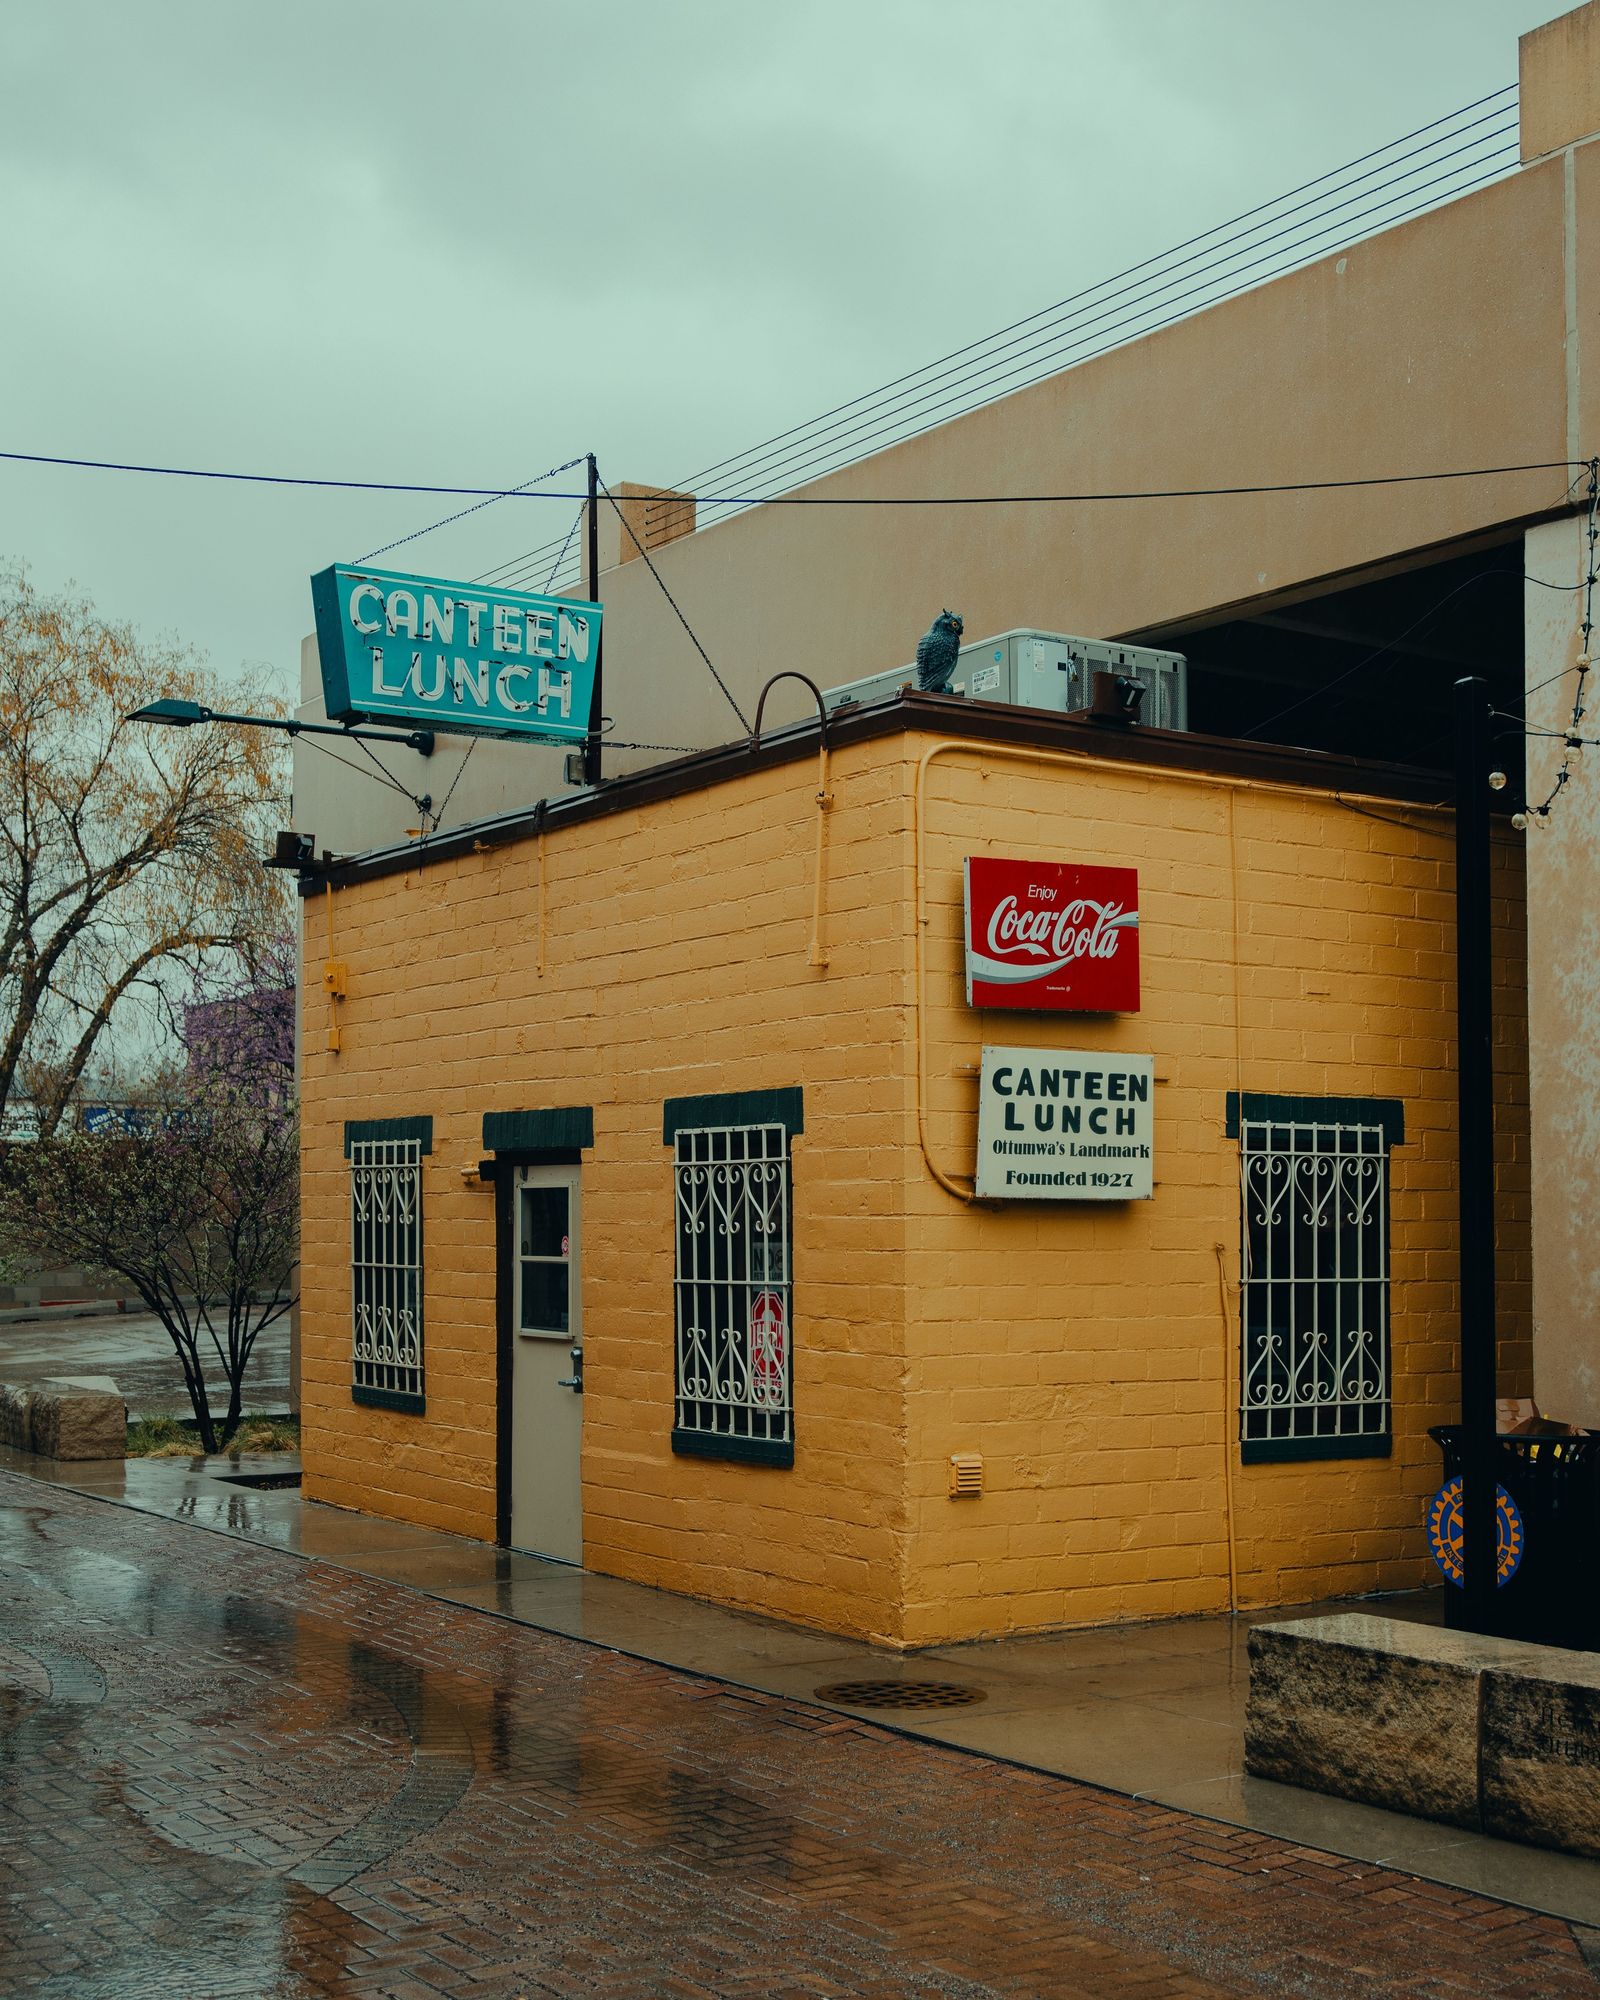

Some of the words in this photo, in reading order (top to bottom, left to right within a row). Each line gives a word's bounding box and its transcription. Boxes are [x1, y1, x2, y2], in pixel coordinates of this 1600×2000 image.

[349, 584, 589, 663] CANTEEN
[372, 646, 572, 718] LUNCH
[1027, 884, 1058, 901] Enjoy
[987, 895, 1124, 959] Coca-Cola
[992, 1067, 1148, 1102] CANTEEN
[1004, 1102, 1135, 1135] LUNCH
[992, 1139, 1065, 1156] Ottumwa's
[1069, 1142, 1150, 1159] Landmark
[1005, 1170, 1087, 1186] Founded
[1089, 1172, 1134, 1188] 1927
